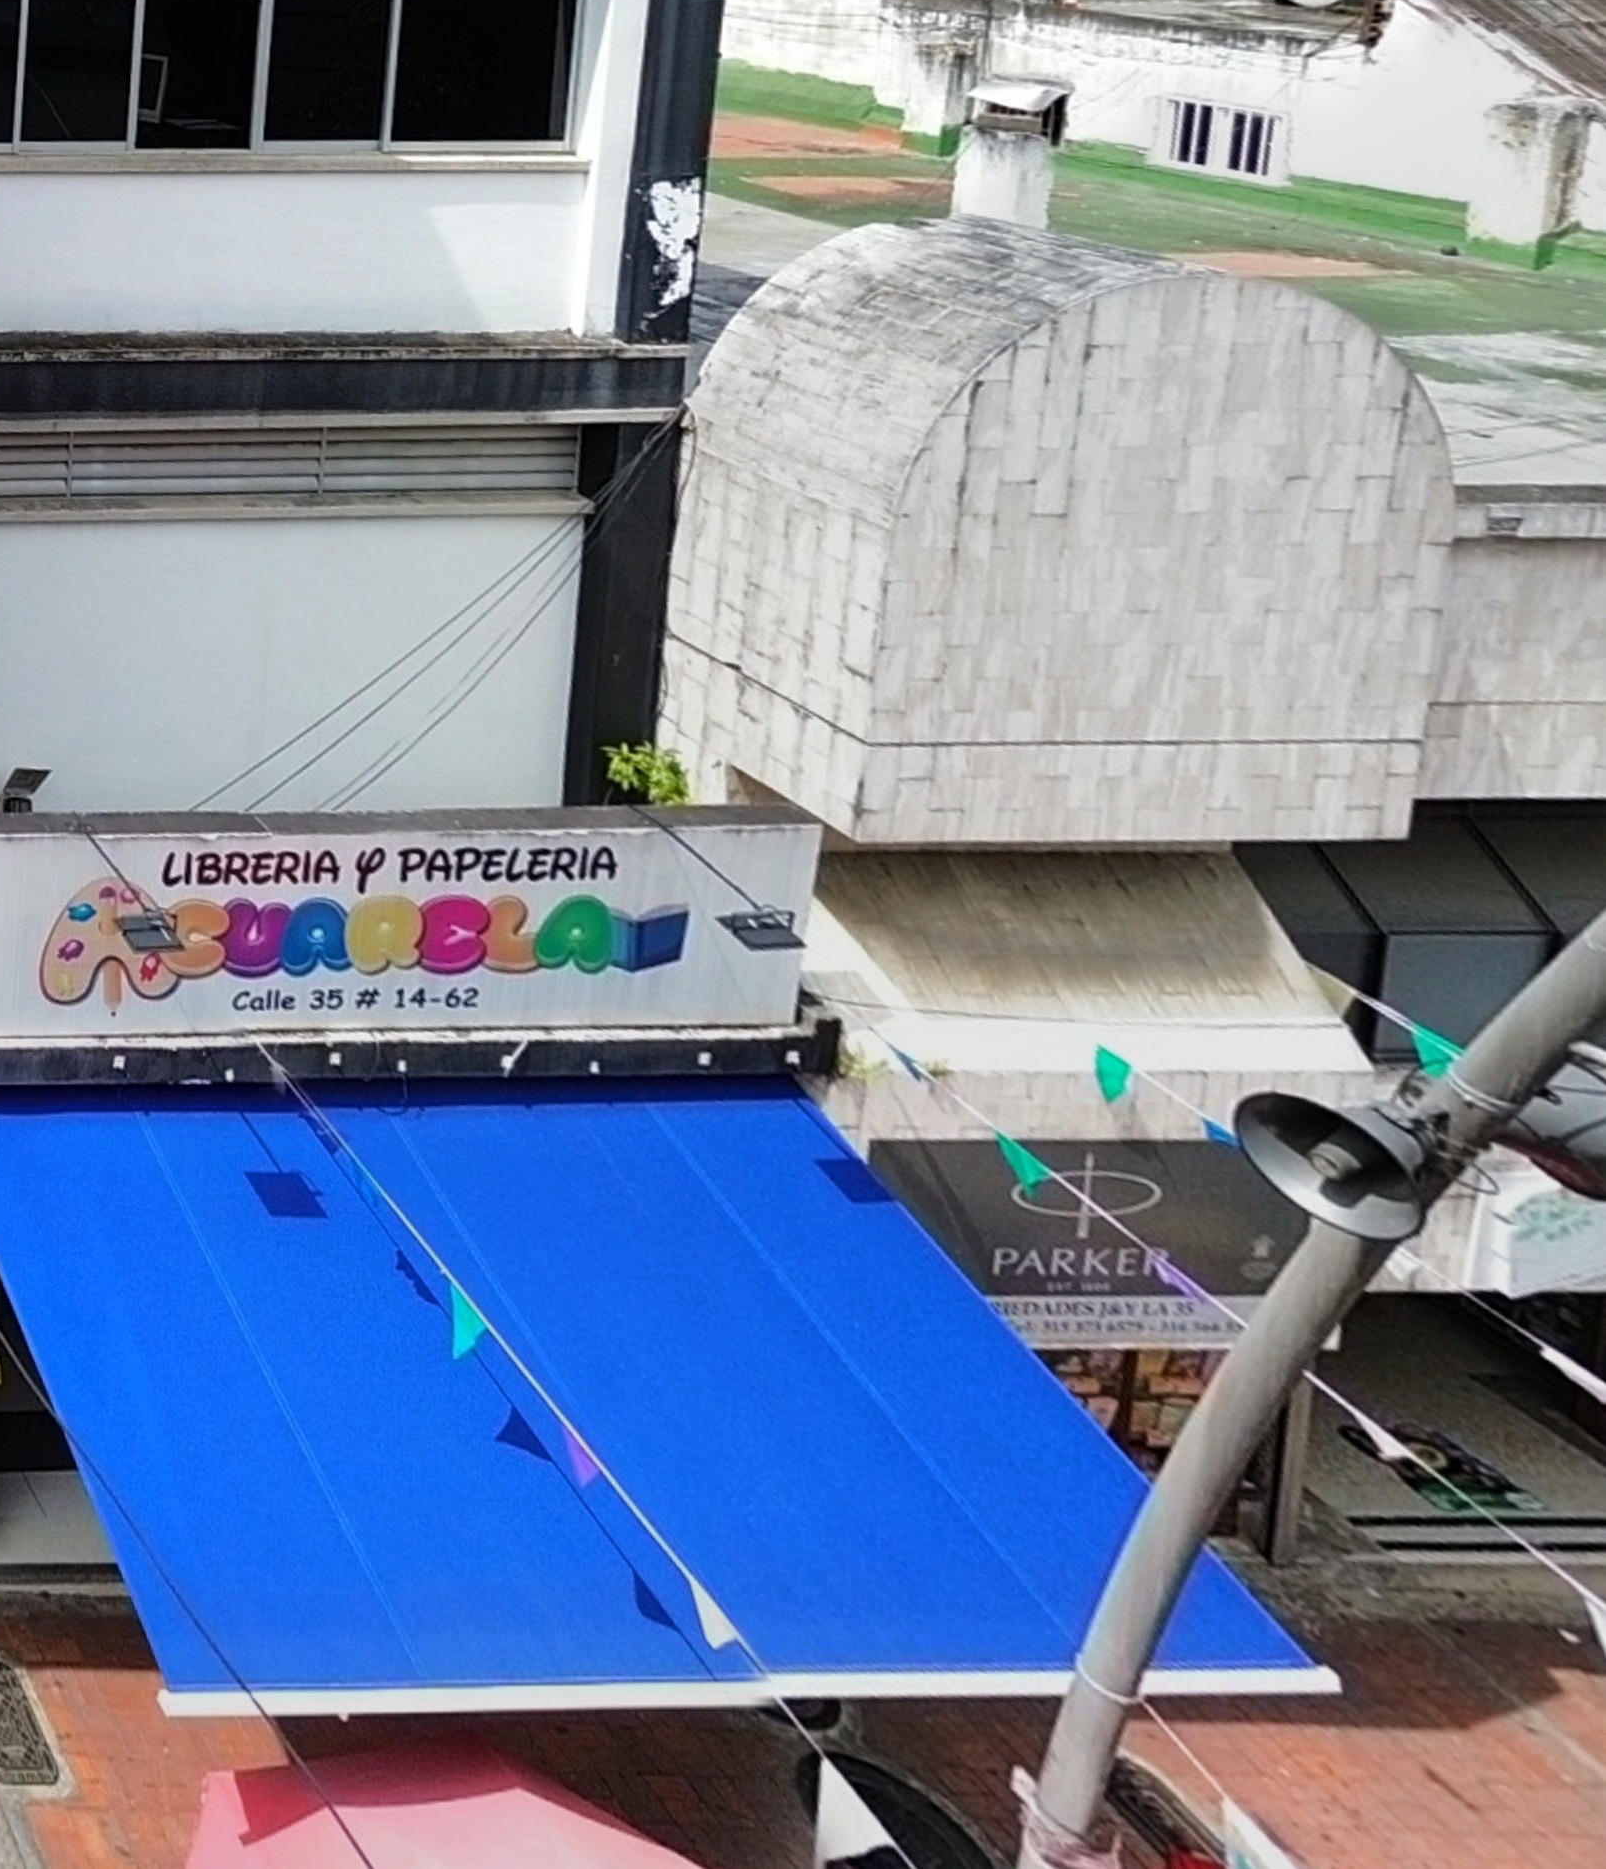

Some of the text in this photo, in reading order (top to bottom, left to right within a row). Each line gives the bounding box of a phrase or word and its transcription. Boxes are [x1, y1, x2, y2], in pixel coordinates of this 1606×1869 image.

[161, 849, 341, 886] LIBRERIA
[397, 845, 619, 883] PAPELERIA
[232, 986, 481, 1012] Calle 35 # 14-62
[991, 1246, 1170, 1277] PARKER
